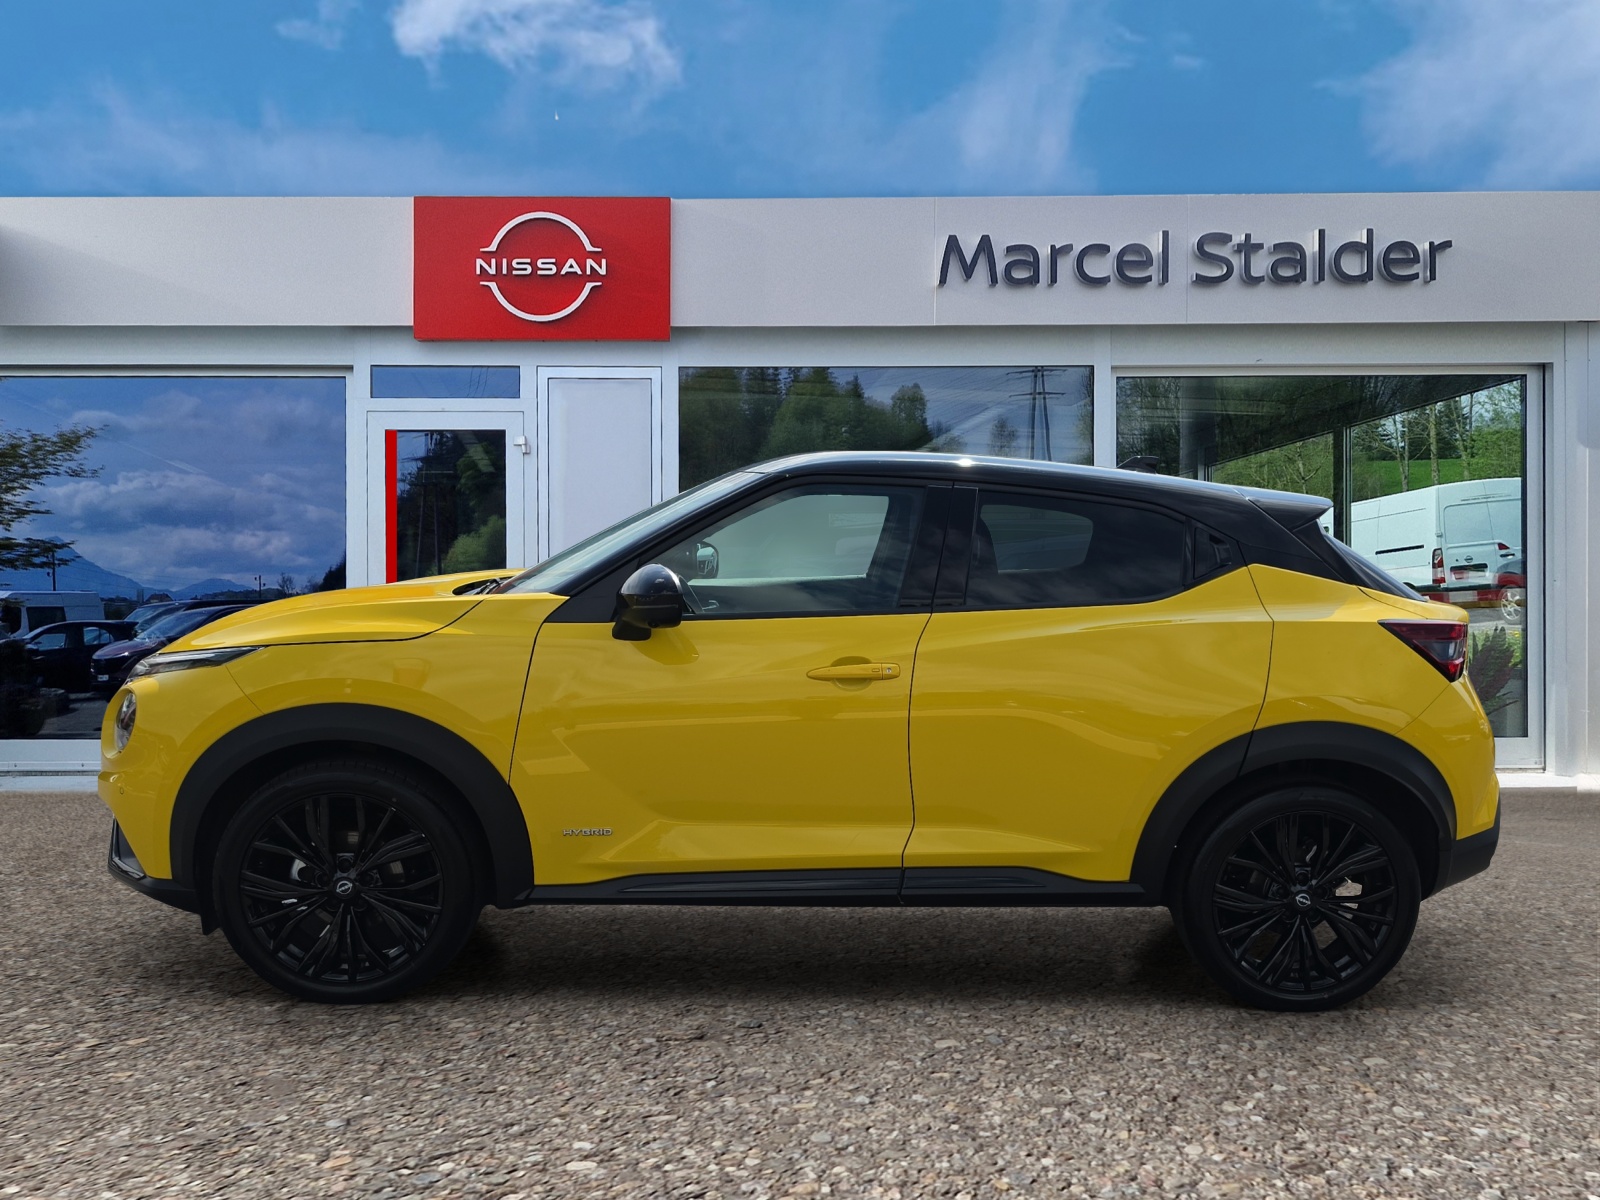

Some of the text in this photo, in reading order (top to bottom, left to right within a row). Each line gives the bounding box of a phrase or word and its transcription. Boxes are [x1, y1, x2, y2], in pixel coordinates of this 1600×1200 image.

[475, 257, 607, 276] NISSAN
[938, 228, 1453, 287] Marcel Stalder
[563, 828, 613, 836] HYBRID
